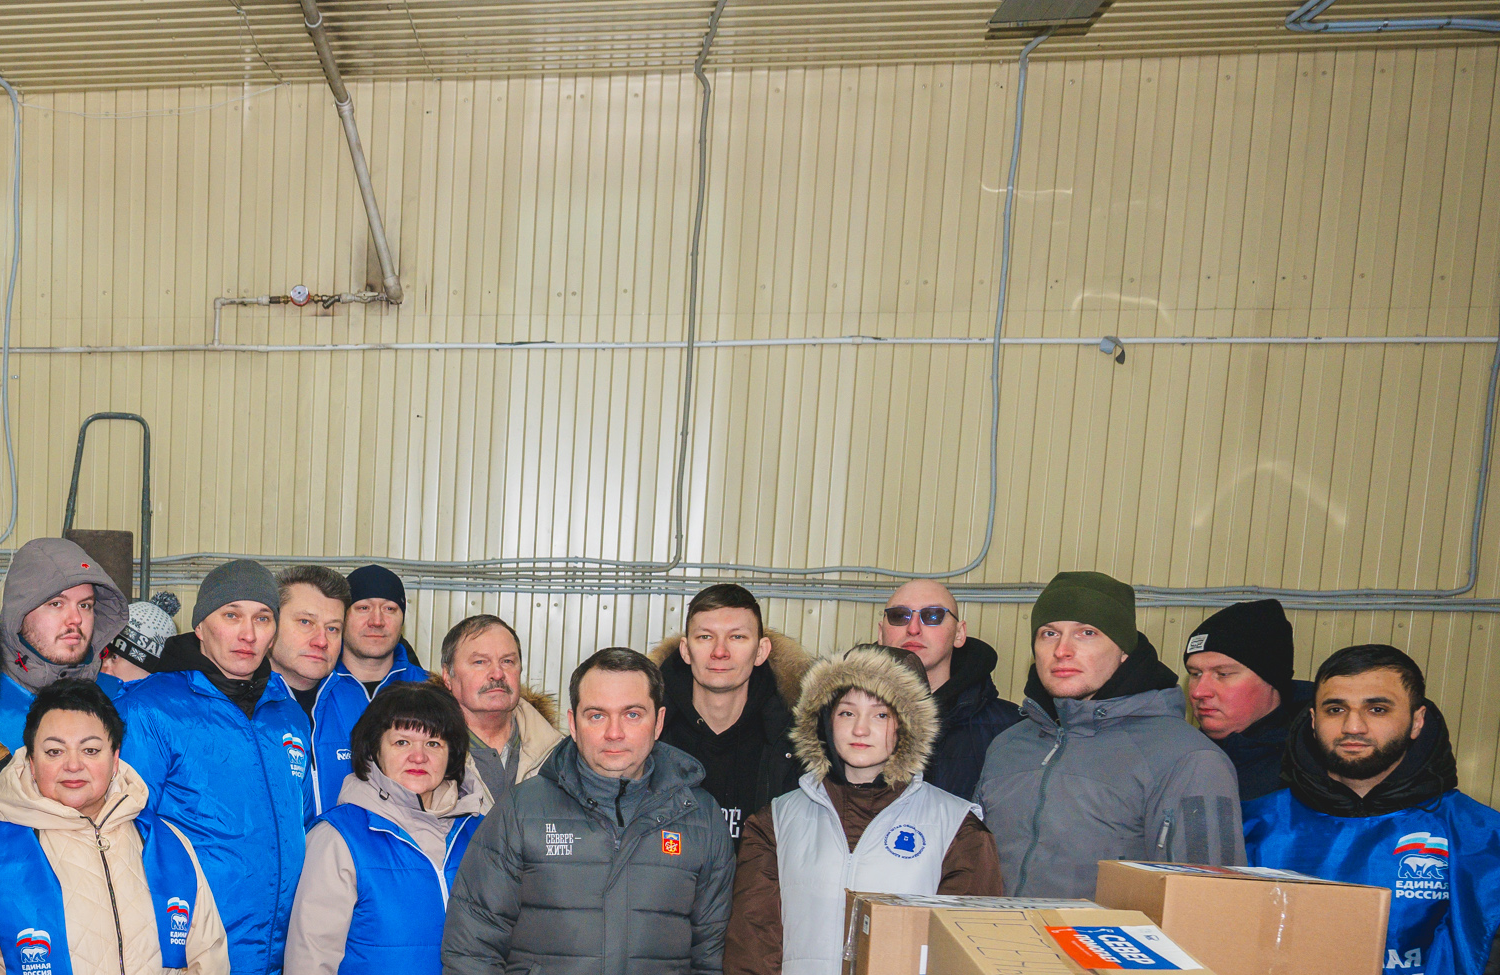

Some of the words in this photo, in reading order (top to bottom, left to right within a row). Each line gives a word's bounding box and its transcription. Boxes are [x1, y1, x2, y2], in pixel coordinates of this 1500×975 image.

[546, 823, 556, 833] НА
[1396, 881, 1449, 889] ЕДИНАЯ
[1396, 890, 1449, 900] РОССИЯ
[1074, 934, 1122, 964] ПОМОГАЕТ
[1098, 934, 1156, 965] СЕВЕР
[1383, 948, 1422, 970] АЯ
[22, 963, 51, 971] ЕДИНАЯ
